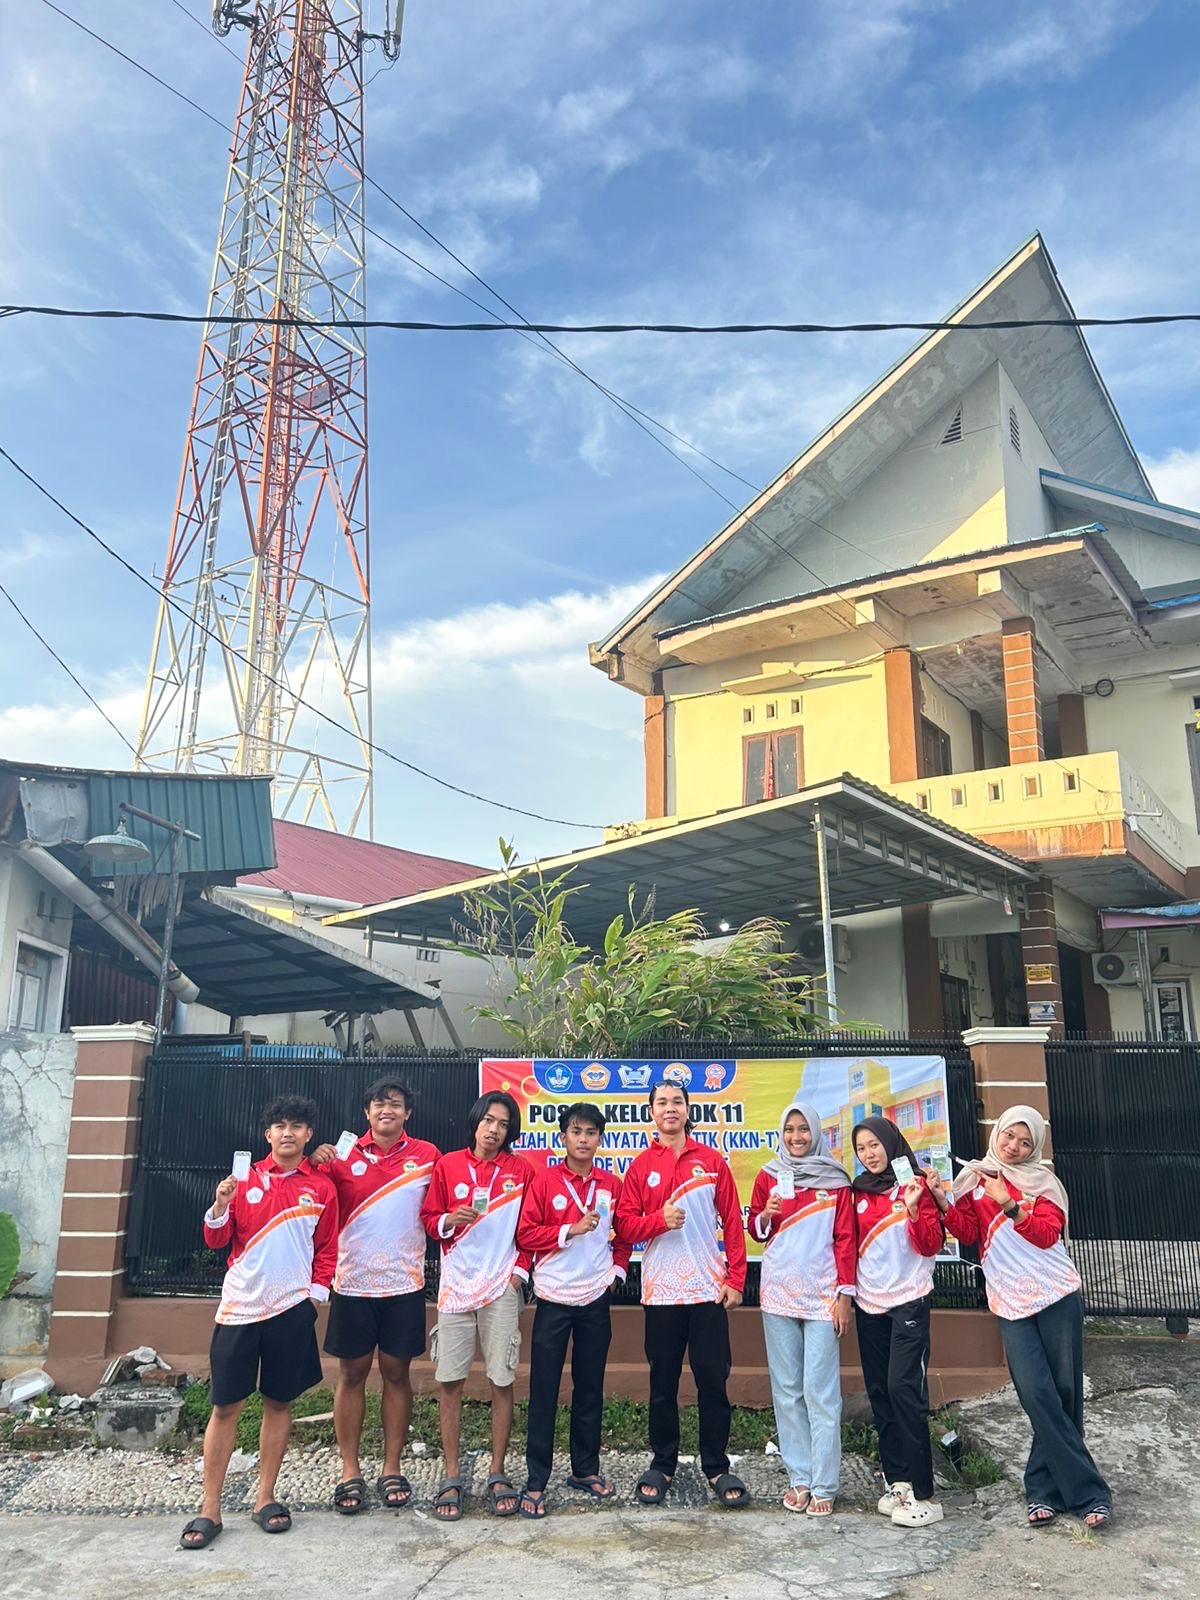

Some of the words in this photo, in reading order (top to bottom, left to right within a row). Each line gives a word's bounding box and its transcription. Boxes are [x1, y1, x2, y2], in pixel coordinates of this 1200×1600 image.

[604, 1104, 718, 1123] KELOOK
[721, 1103, 743, 1123] 11
[601, 1131, 649, 1149] NYATA
[722, 1130, 780, 1152] (KKN-T)
